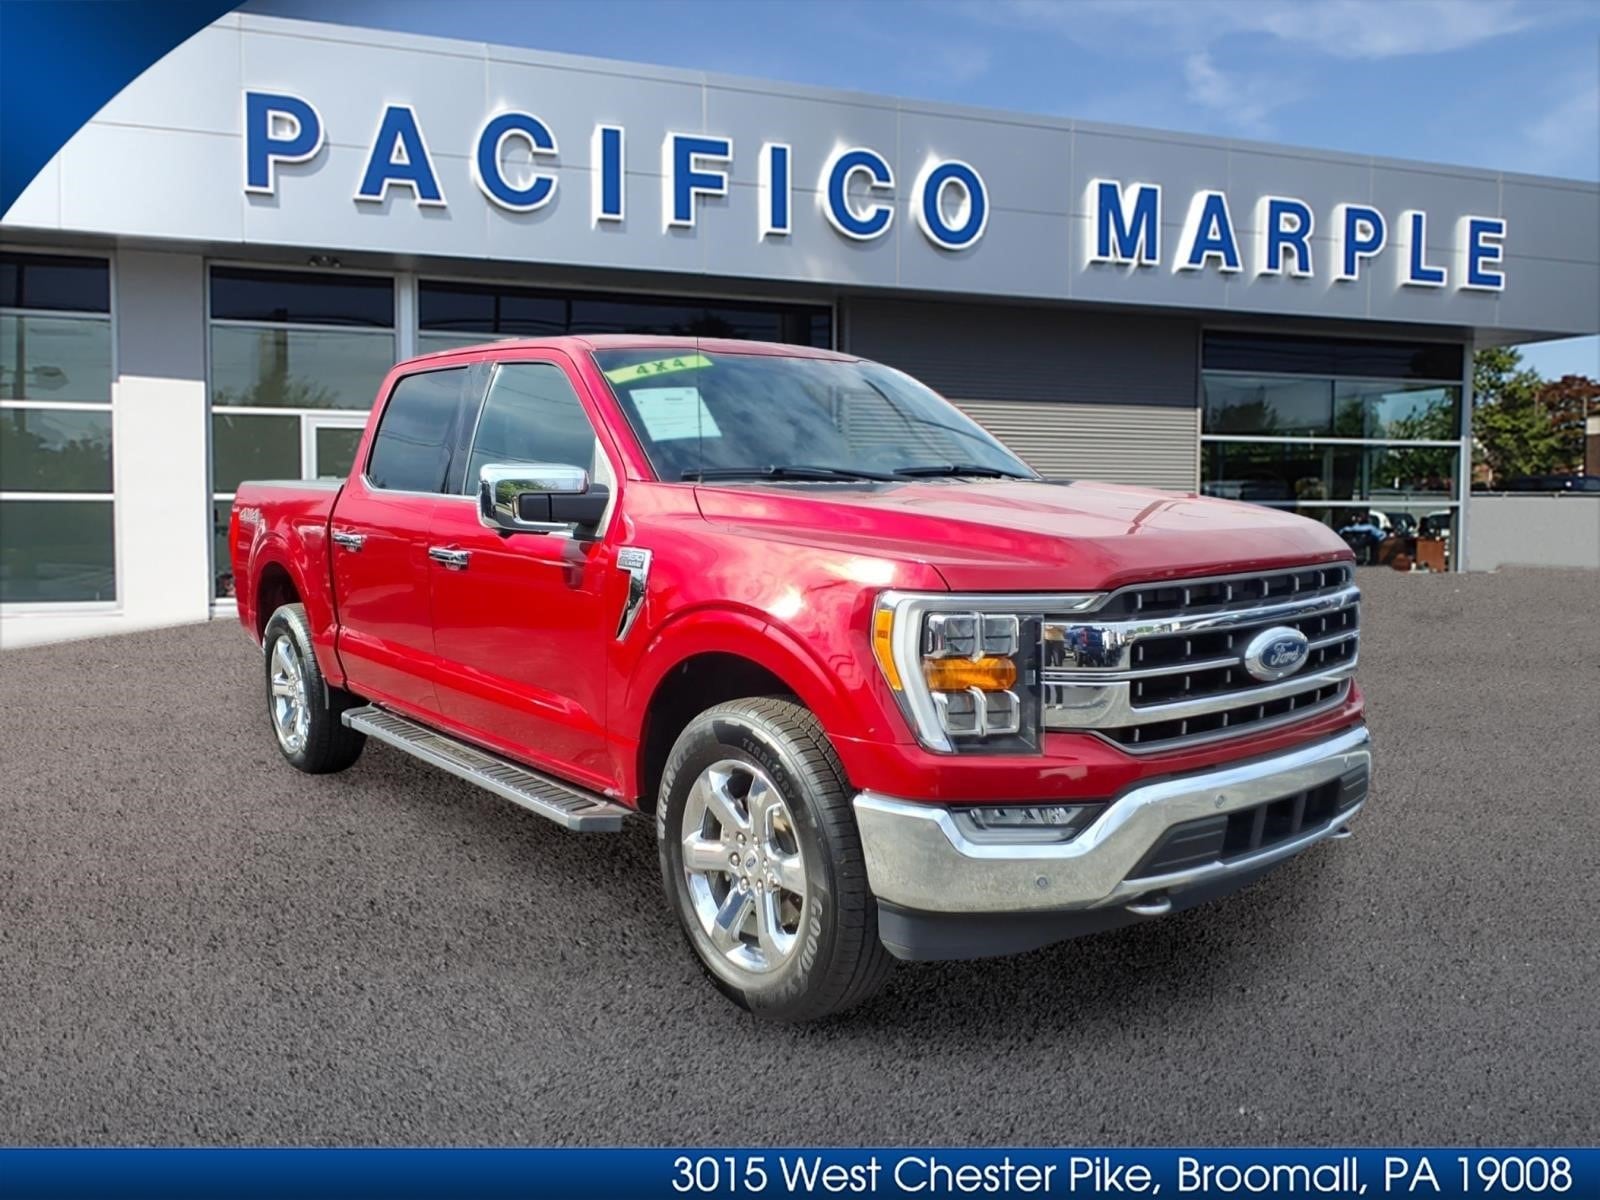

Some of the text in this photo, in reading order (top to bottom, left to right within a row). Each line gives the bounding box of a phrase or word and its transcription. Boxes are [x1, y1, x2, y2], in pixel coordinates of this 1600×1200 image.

[242, 88, 1507, 291] PACIFICO MARPLE
[636, 358, 687, 374] 4X4
[1270, 641, 1300, 666] Ford
